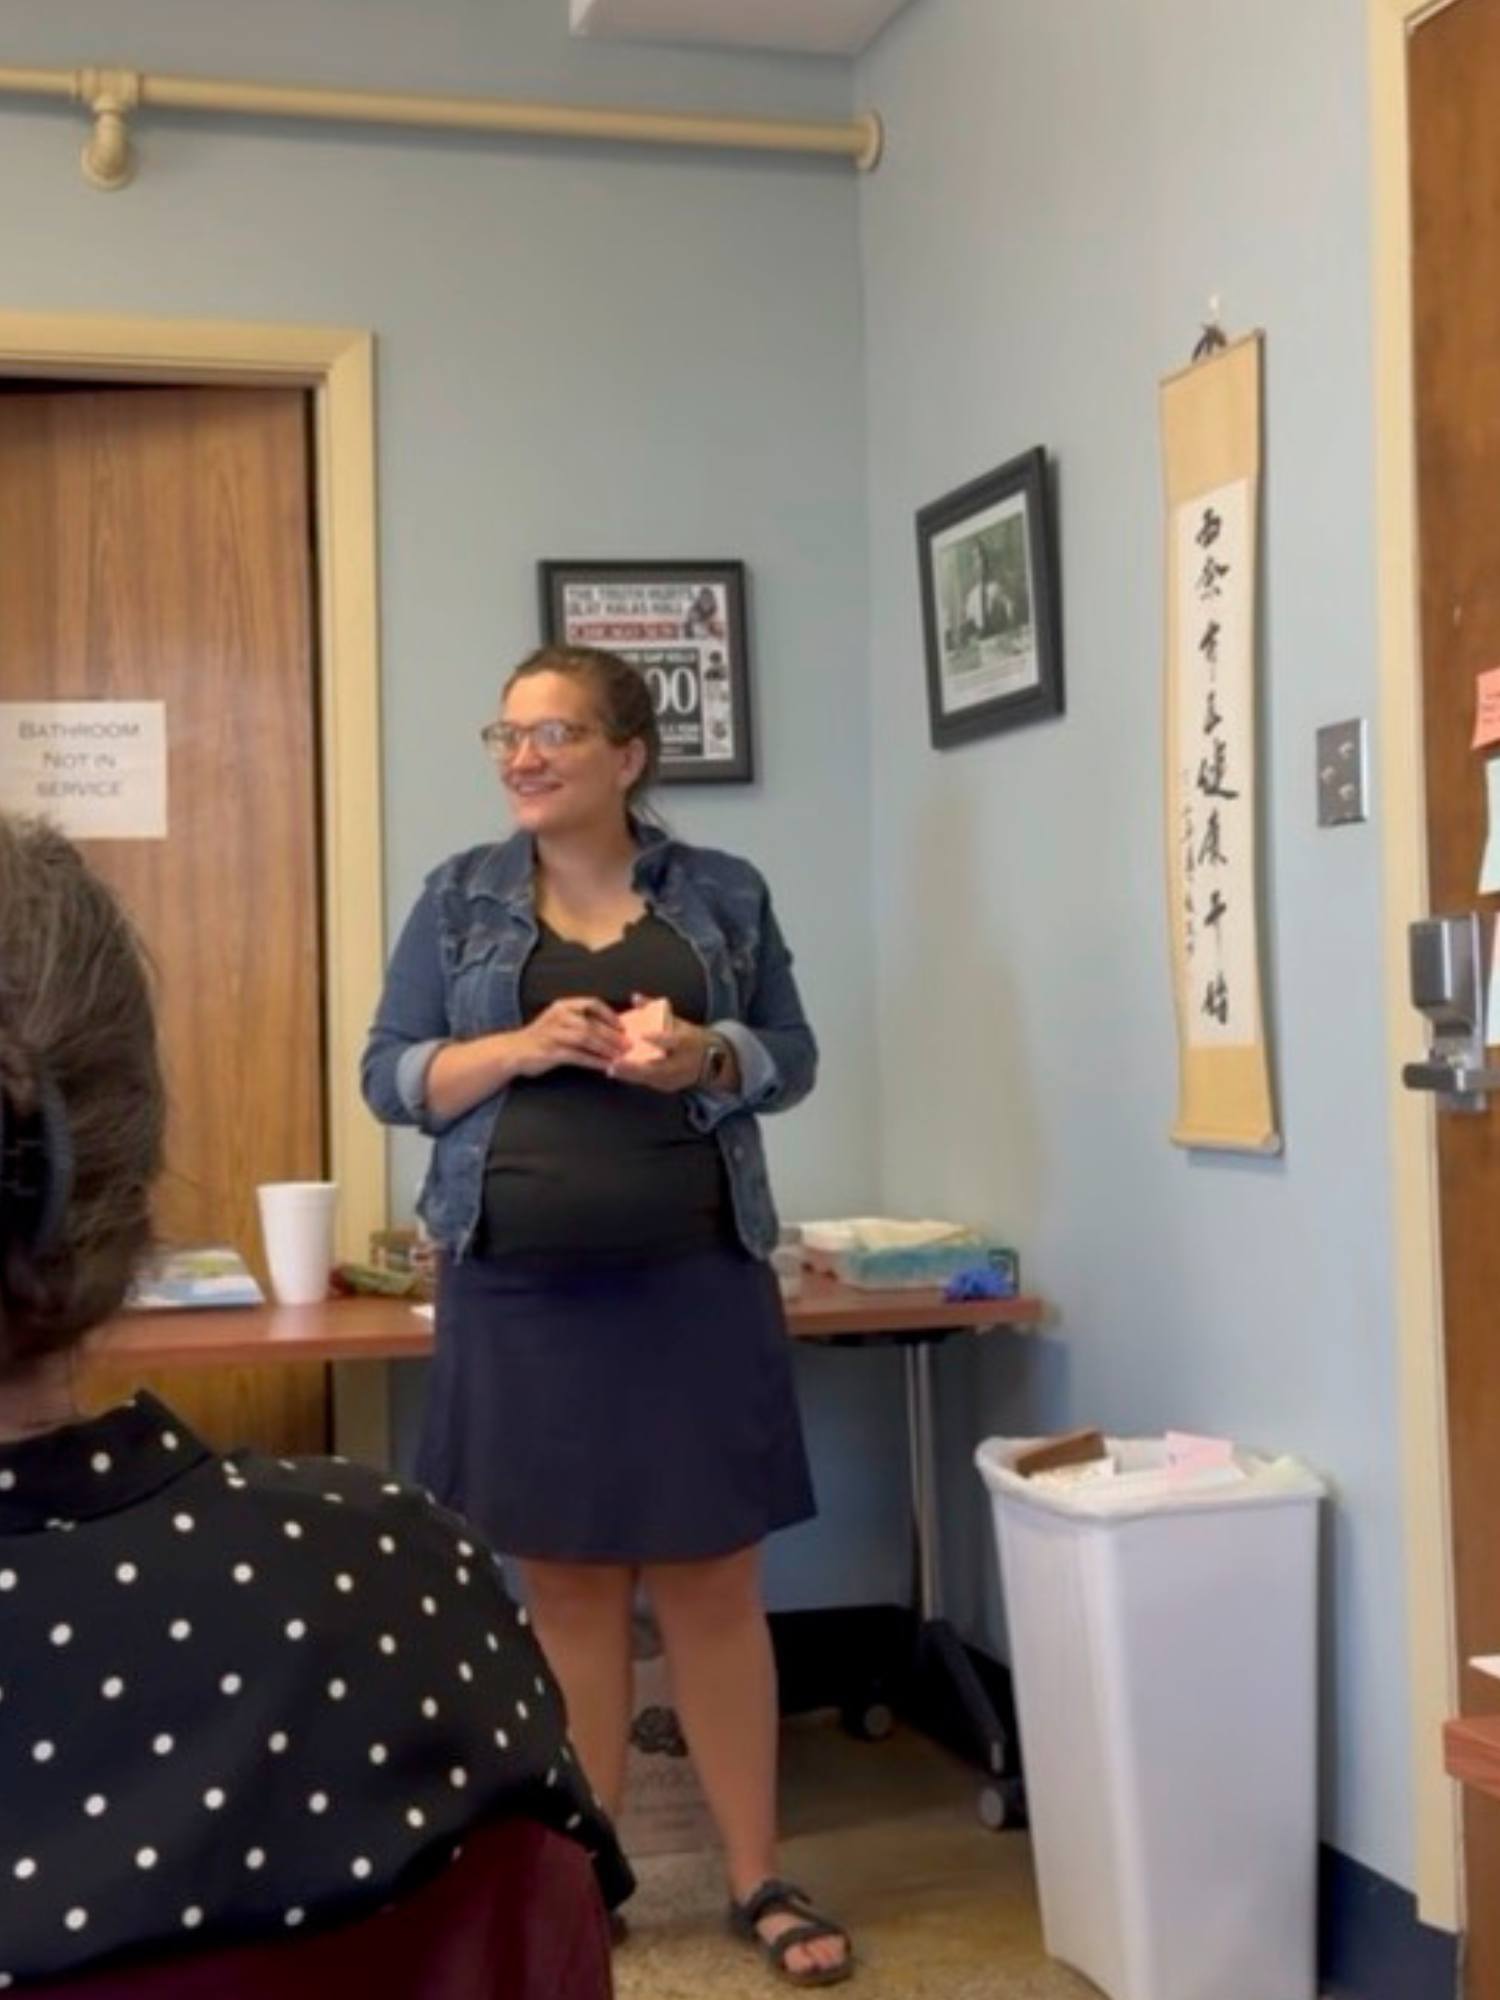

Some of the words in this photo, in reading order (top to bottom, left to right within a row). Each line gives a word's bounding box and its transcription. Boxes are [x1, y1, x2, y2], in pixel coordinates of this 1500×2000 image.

[18, 719, 140, 739] BATHROOM
[43, 752, 89, 769] NOT
[94, 752, 117, 769] IN
[36, 781, 122, 797] SERVICE
